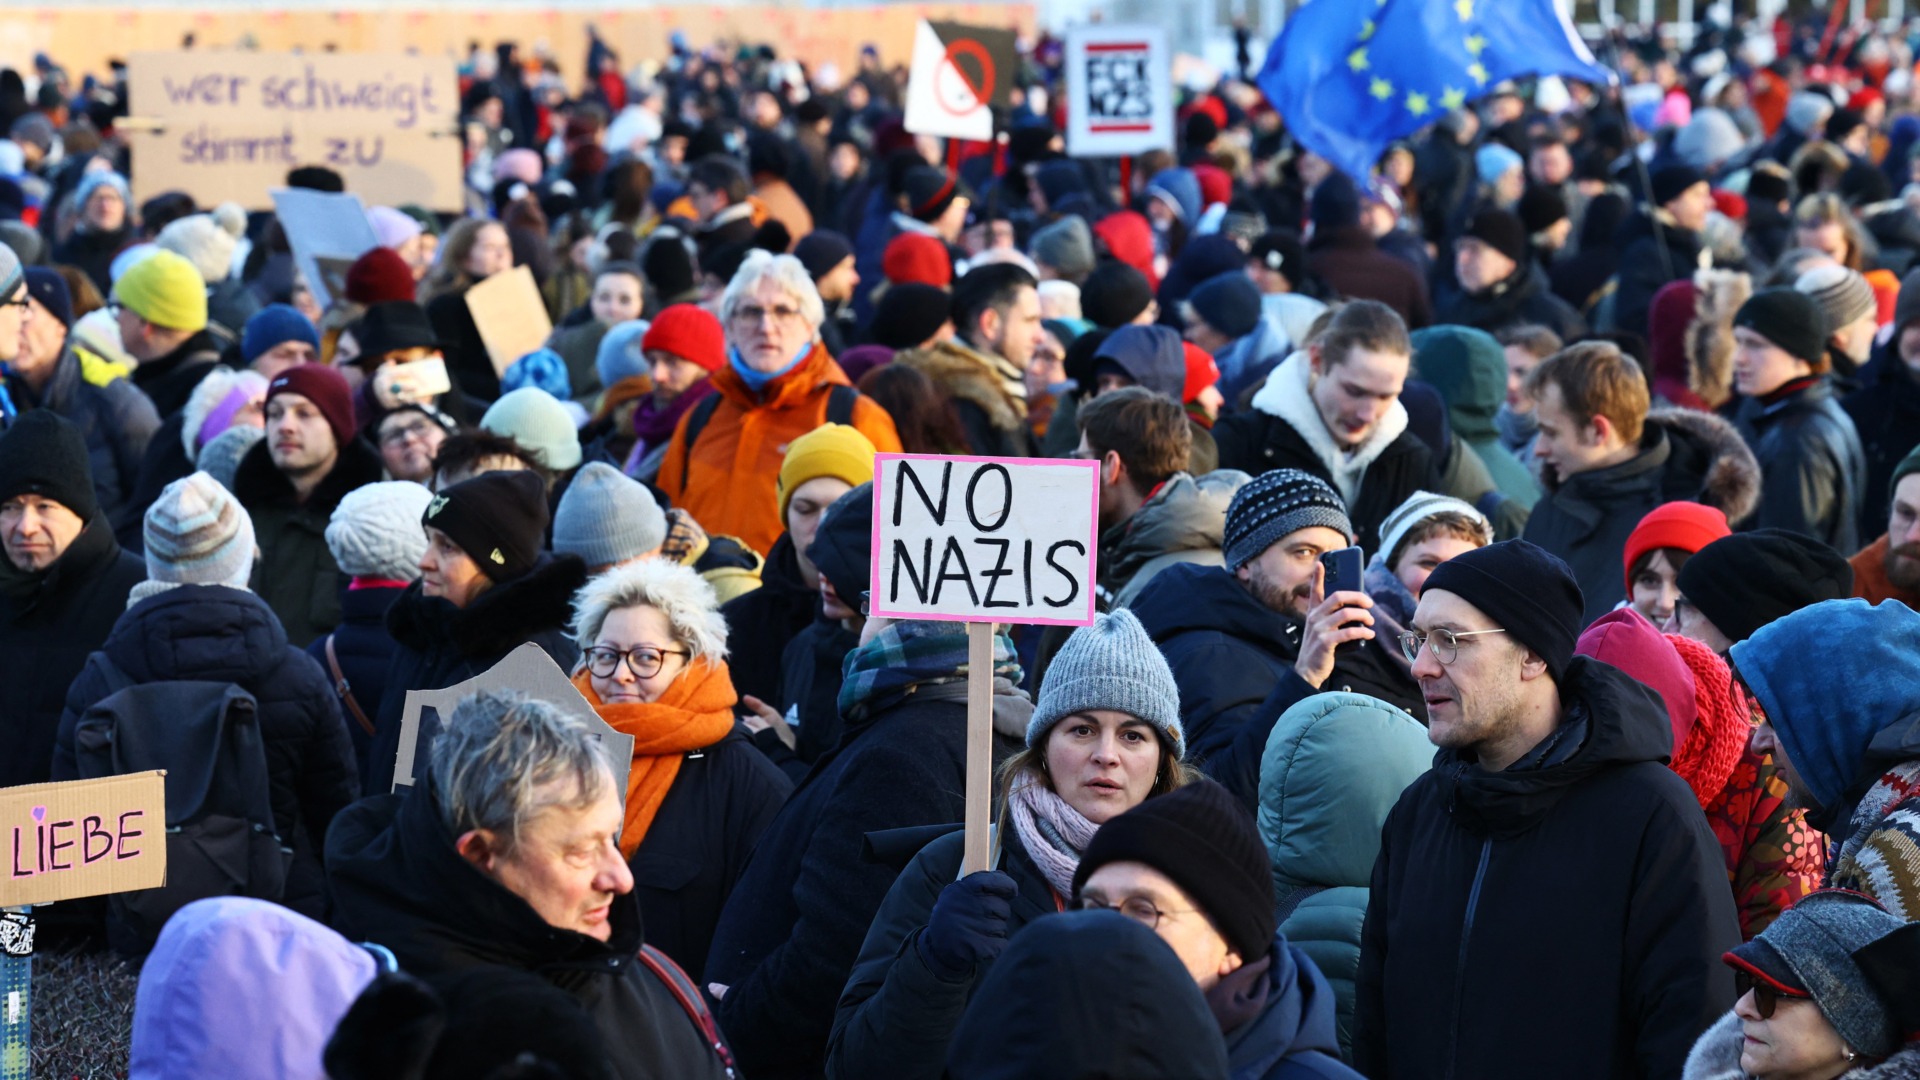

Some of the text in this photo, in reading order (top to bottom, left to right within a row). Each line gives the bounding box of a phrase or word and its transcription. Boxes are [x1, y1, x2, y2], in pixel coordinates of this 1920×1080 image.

[164, 66, 439, 128] wer schweigt
[1086, 57, 1150, 87] FCK
[1087, 88, 1153, 117] NZS
[892, 460, 1013, 532] NO
[890, 535, 1086, 608] NAZIS
